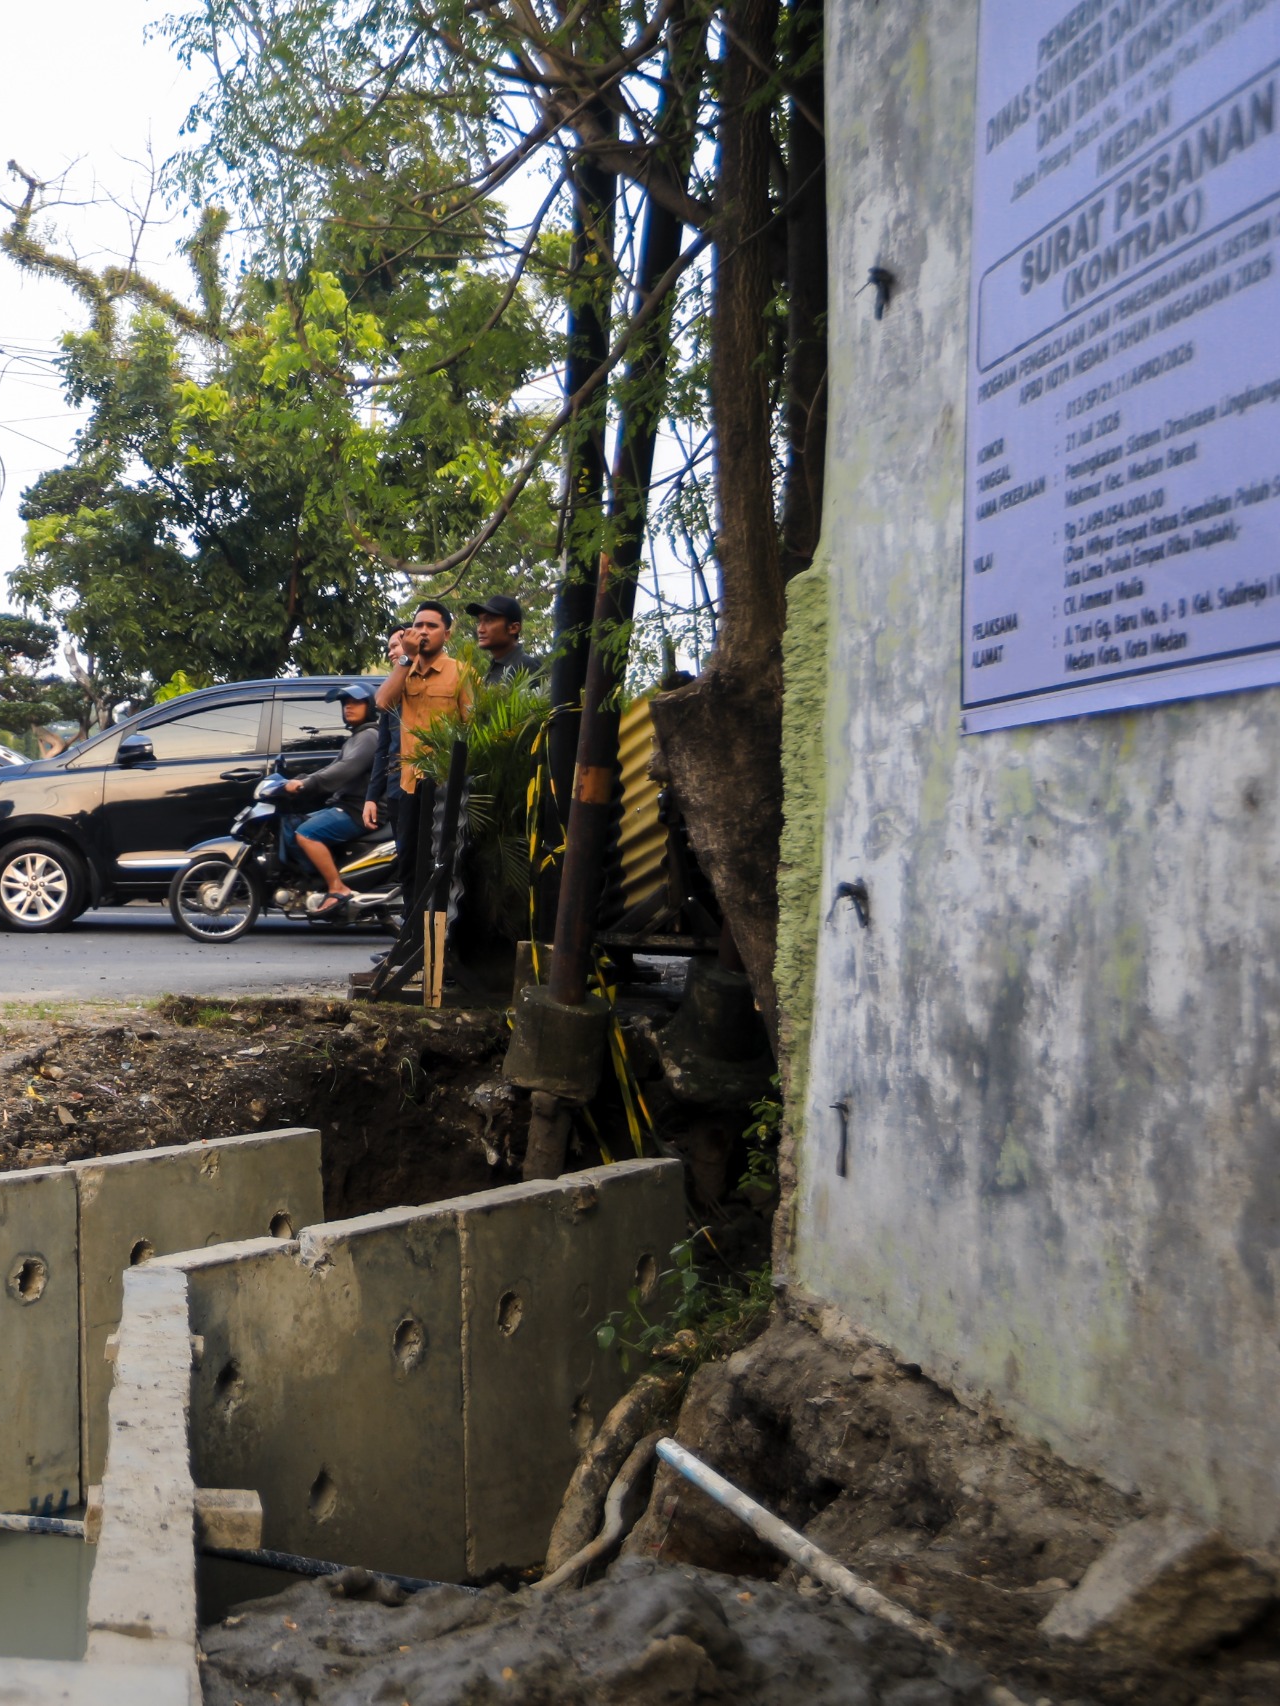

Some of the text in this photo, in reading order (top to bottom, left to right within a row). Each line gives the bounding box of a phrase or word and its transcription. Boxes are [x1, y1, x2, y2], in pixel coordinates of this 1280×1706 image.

[1036, 92, 1070, 152] DAN
[1096, 92, 1171, 176] MEDAN
[1021, 81, 1275, 294] SURAT PESANAN
[1062, 189, 1204, 310] (KONTRAK)
[977, 365, 1017, 402] PROGRAM
[1018, 324, 1086, 377] PENGELOLAAN
[1087, 308, 1110, 339] DAN
[1113, 249, 1218, 320] PENGEMBANGAN
[1044, 361, 1070, 391] KOTA
[1073, 339, 1109, 376] MEDAN
[1111, 316, 1151, 353] TAHUN
[1155, 274, 1231, 331] ANGGARAN
[971, 644, 1004, 669] ALAMAT
[1114, 614, 1138, 634] Baru
[972, 613, 1018, 640] PELAKSANA
[1064, 651, 1095, 672] Medan
[1124, 639, 1149, 660] Kota
[1150, 632, 1188, 653] Medan
